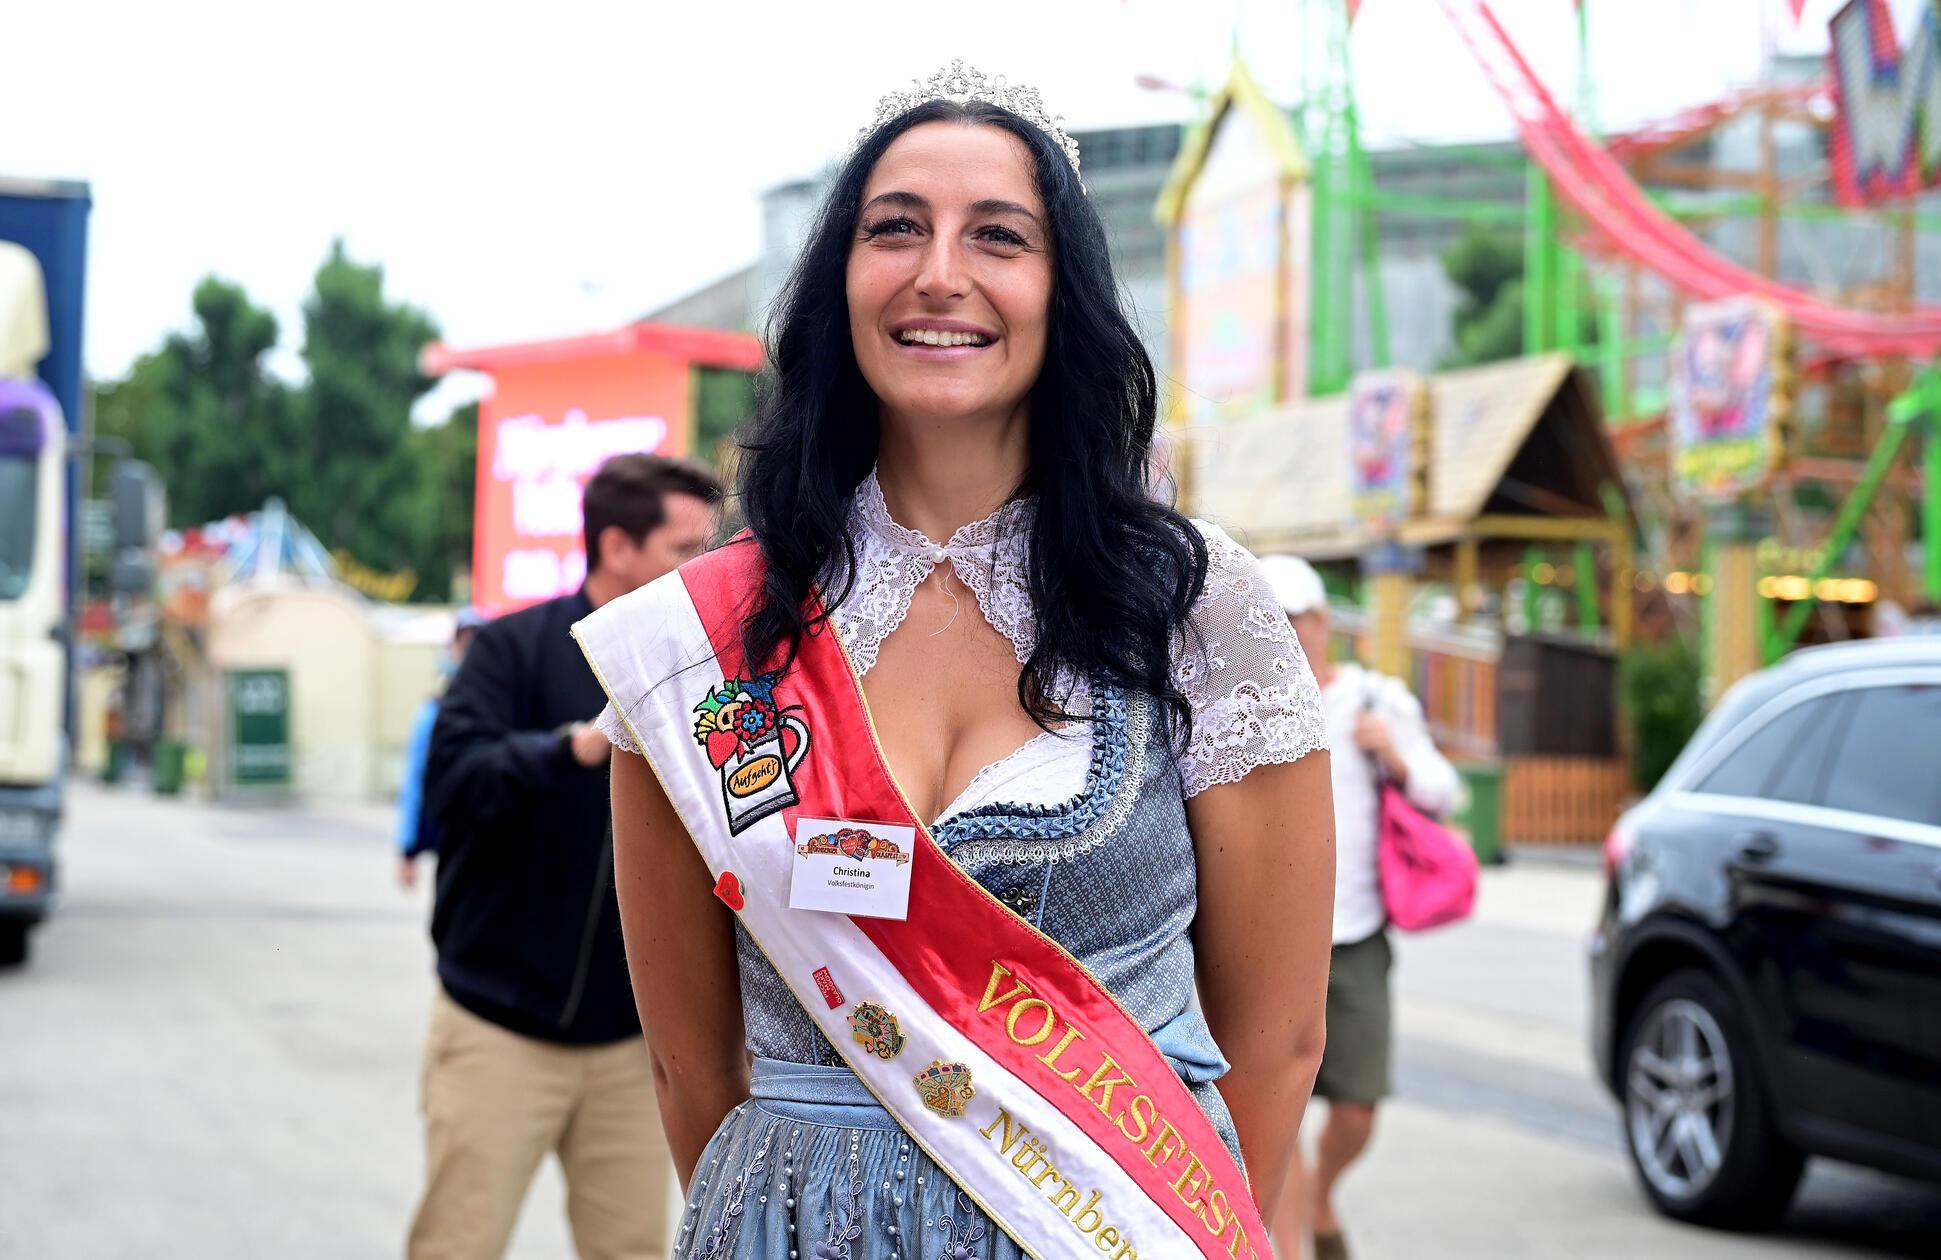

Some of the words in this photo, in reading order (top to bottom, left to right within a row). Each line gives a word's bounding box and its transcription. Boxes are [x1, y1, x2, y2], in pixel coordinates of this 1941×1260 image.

[833, 866, 871, 878] Christina
[827, 879, 875, 891] Volksfestkönigin
[822, 969, 842, 1004] GLASGOW
[977, 960, 1258, 1260] VOLKSFEST
